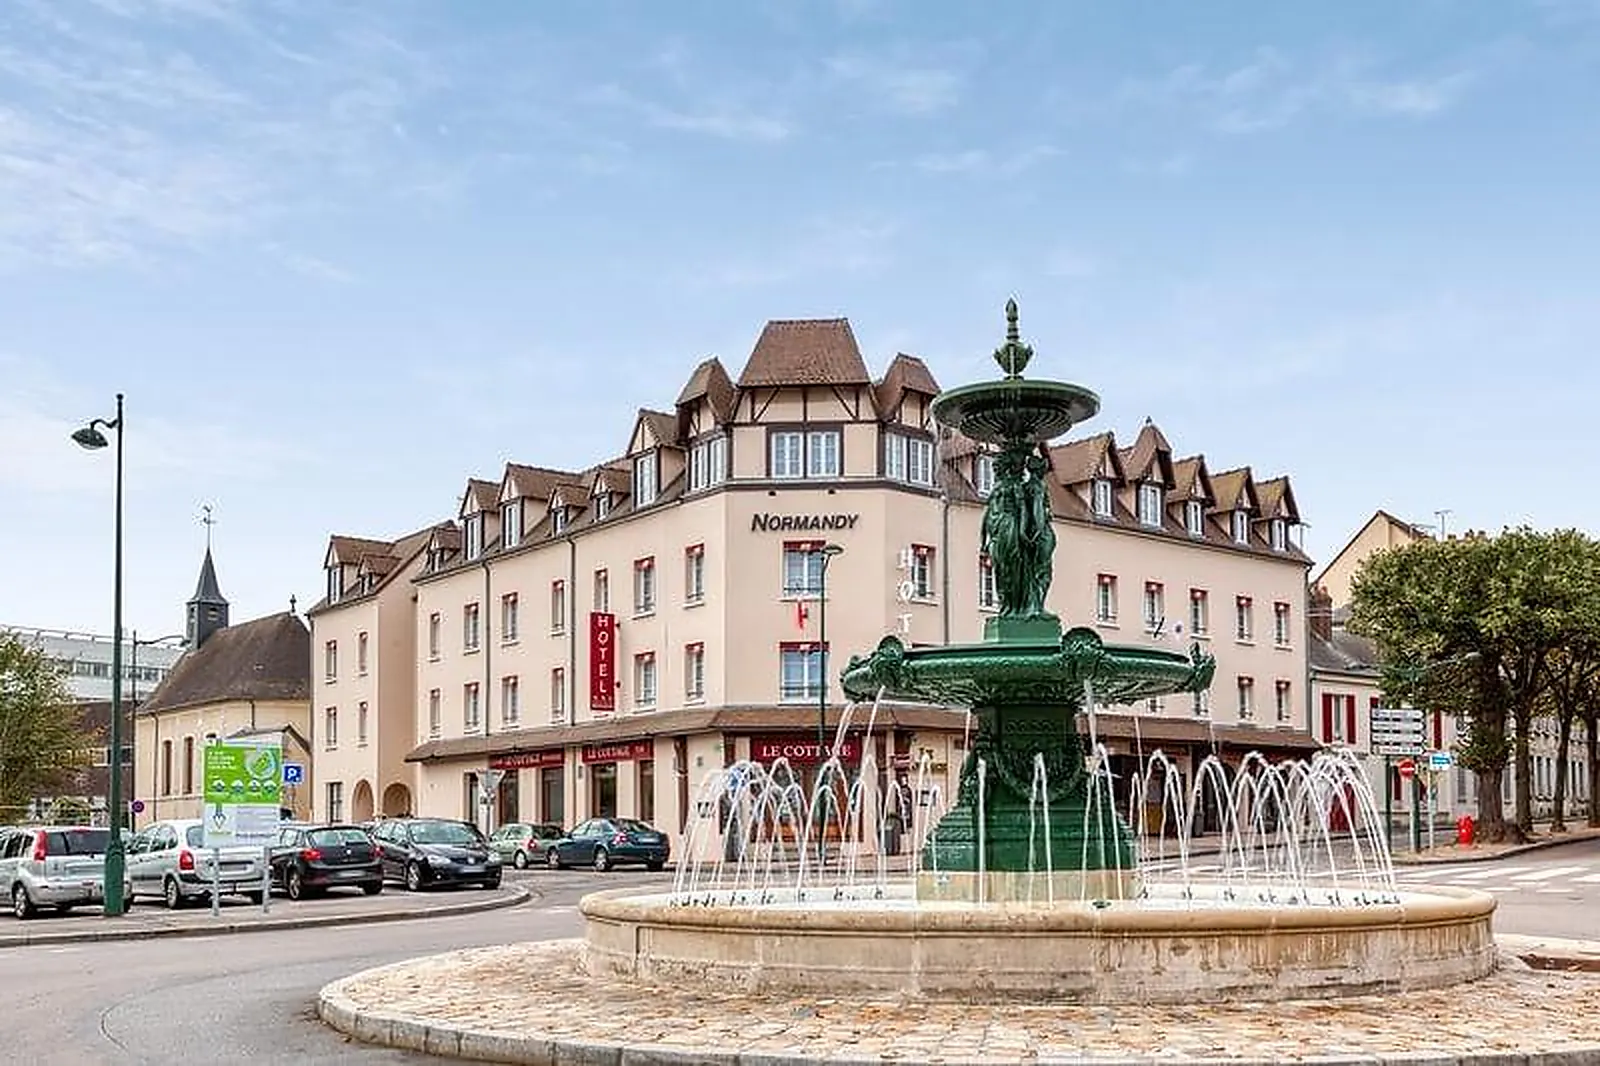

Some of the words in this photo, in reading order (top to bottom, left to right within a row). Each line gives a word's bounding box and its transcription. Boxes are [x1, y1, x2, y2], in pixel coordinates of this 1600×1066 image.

[597, 615, 609, 693] HOTEL
[762, 745, 780, 757] LE
[783, 745, 851, 757] COTTE
